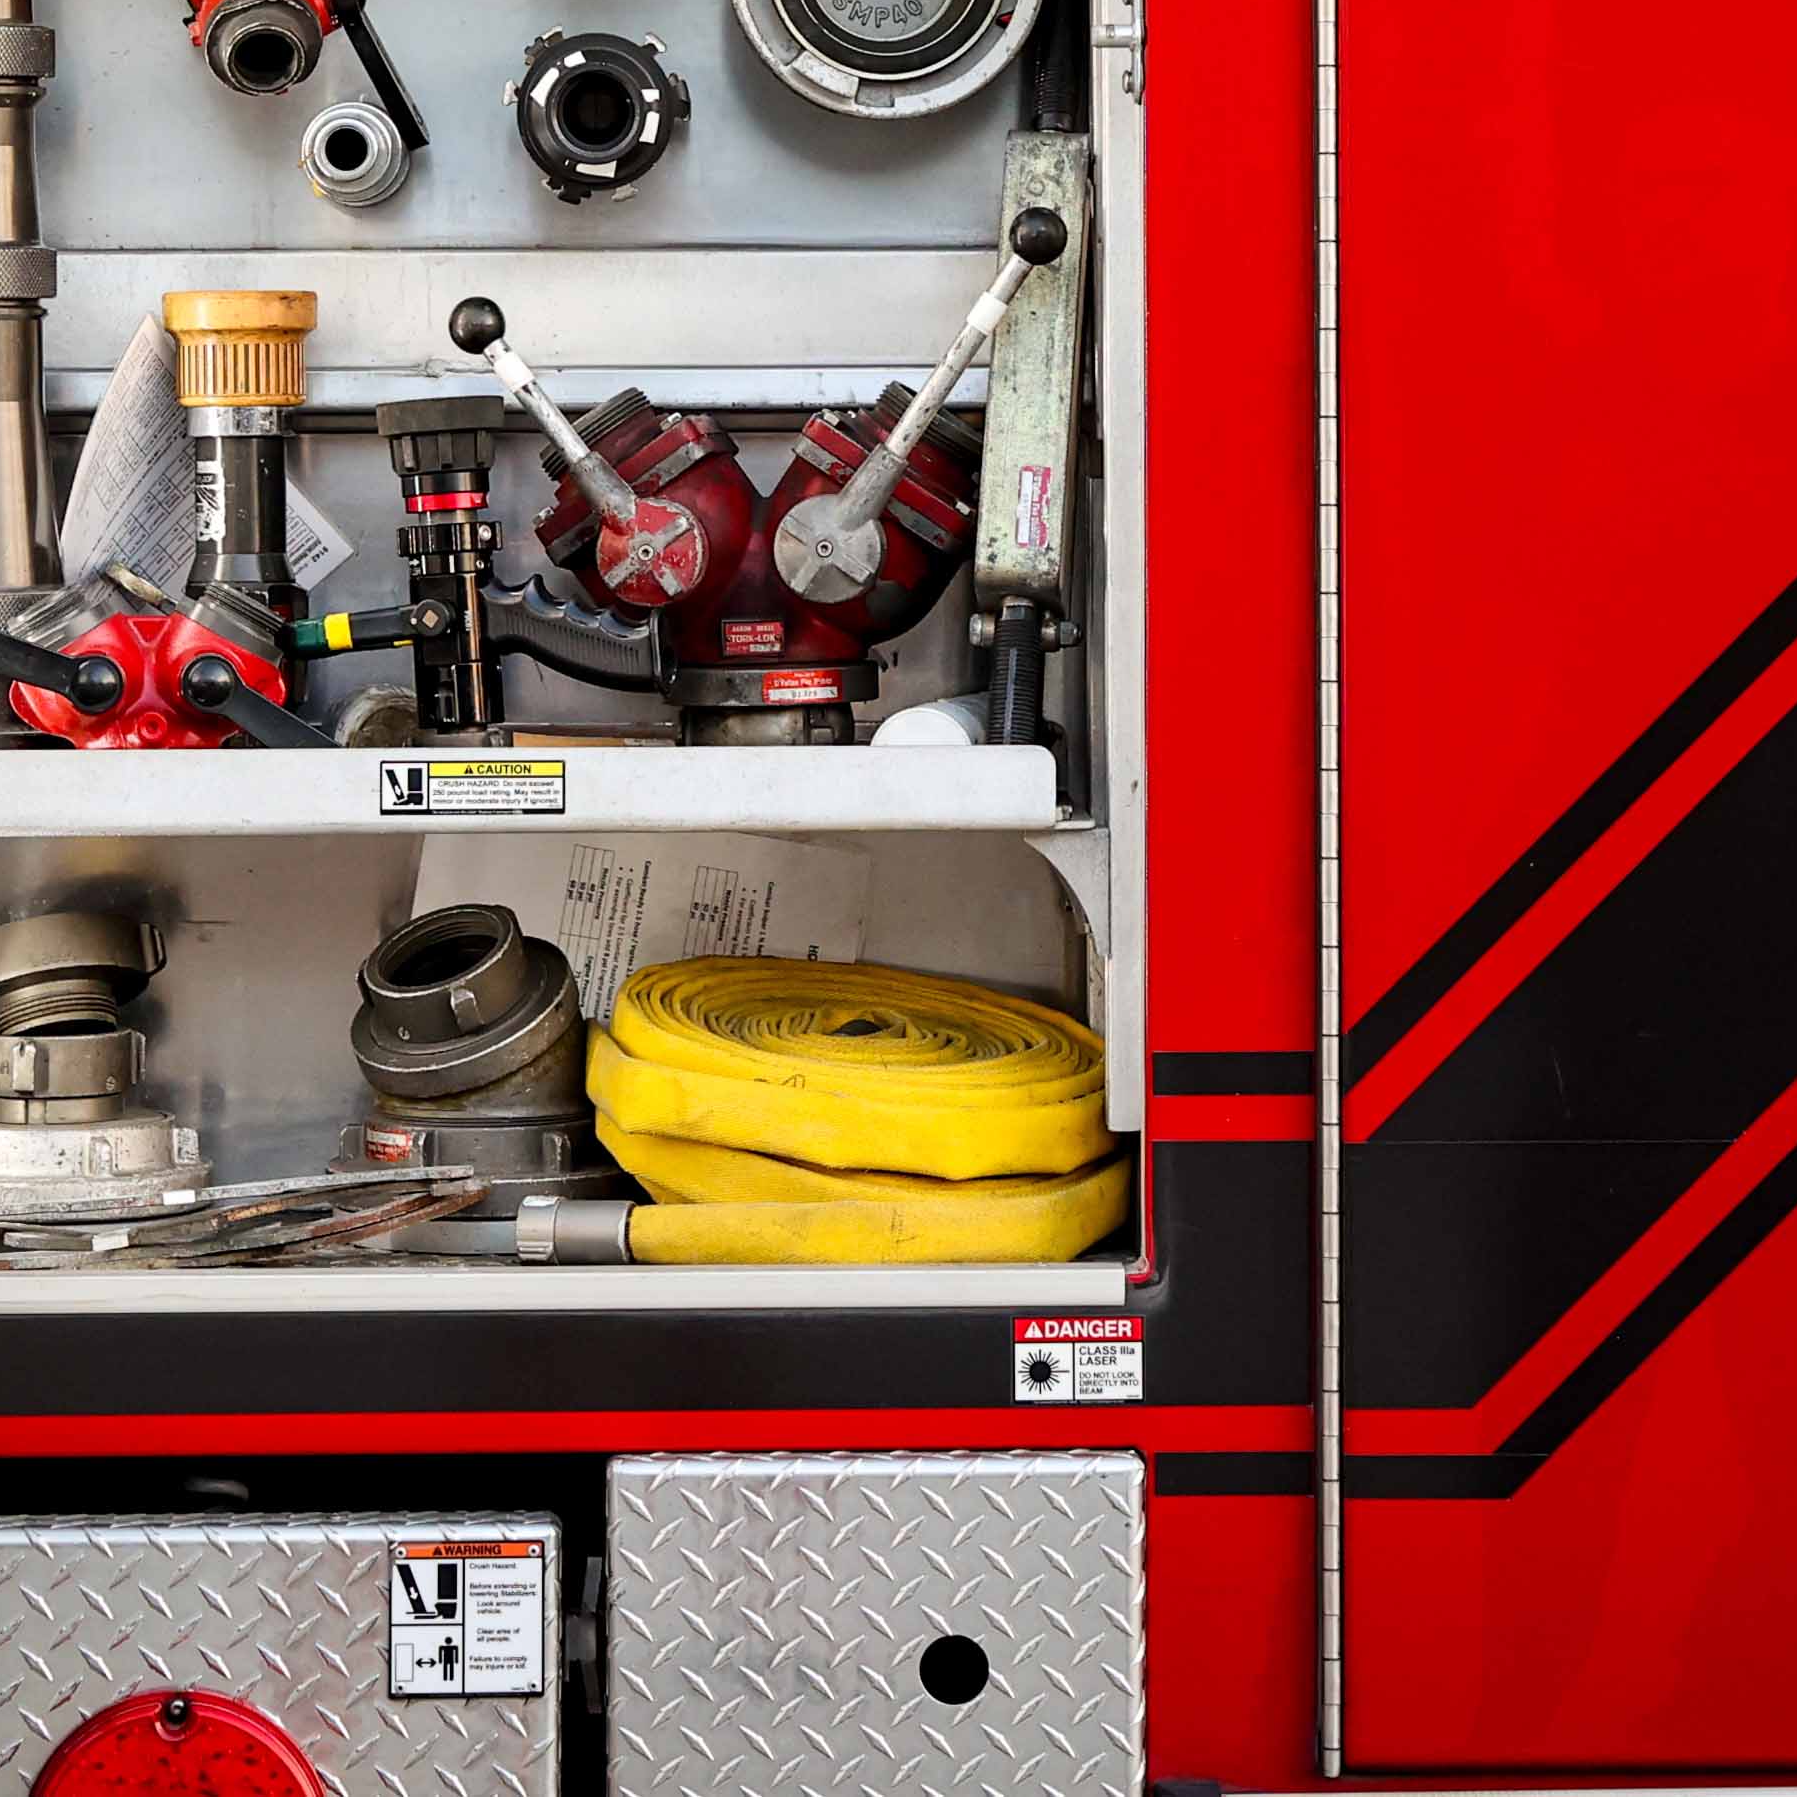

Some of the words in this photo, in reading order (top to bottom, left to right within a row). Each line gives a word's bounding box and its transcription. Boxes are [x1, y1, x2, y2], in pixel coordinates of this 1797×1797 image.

[477, 765, 531, 774] CAUTION
[1045, 1321, 1132, 1337] DANGER
[1079, 1346, 1117, 1355] CLASS
[1079, 1357, 1117, 1365] LASER
[444, 1545, 501, 1555] WARNING
